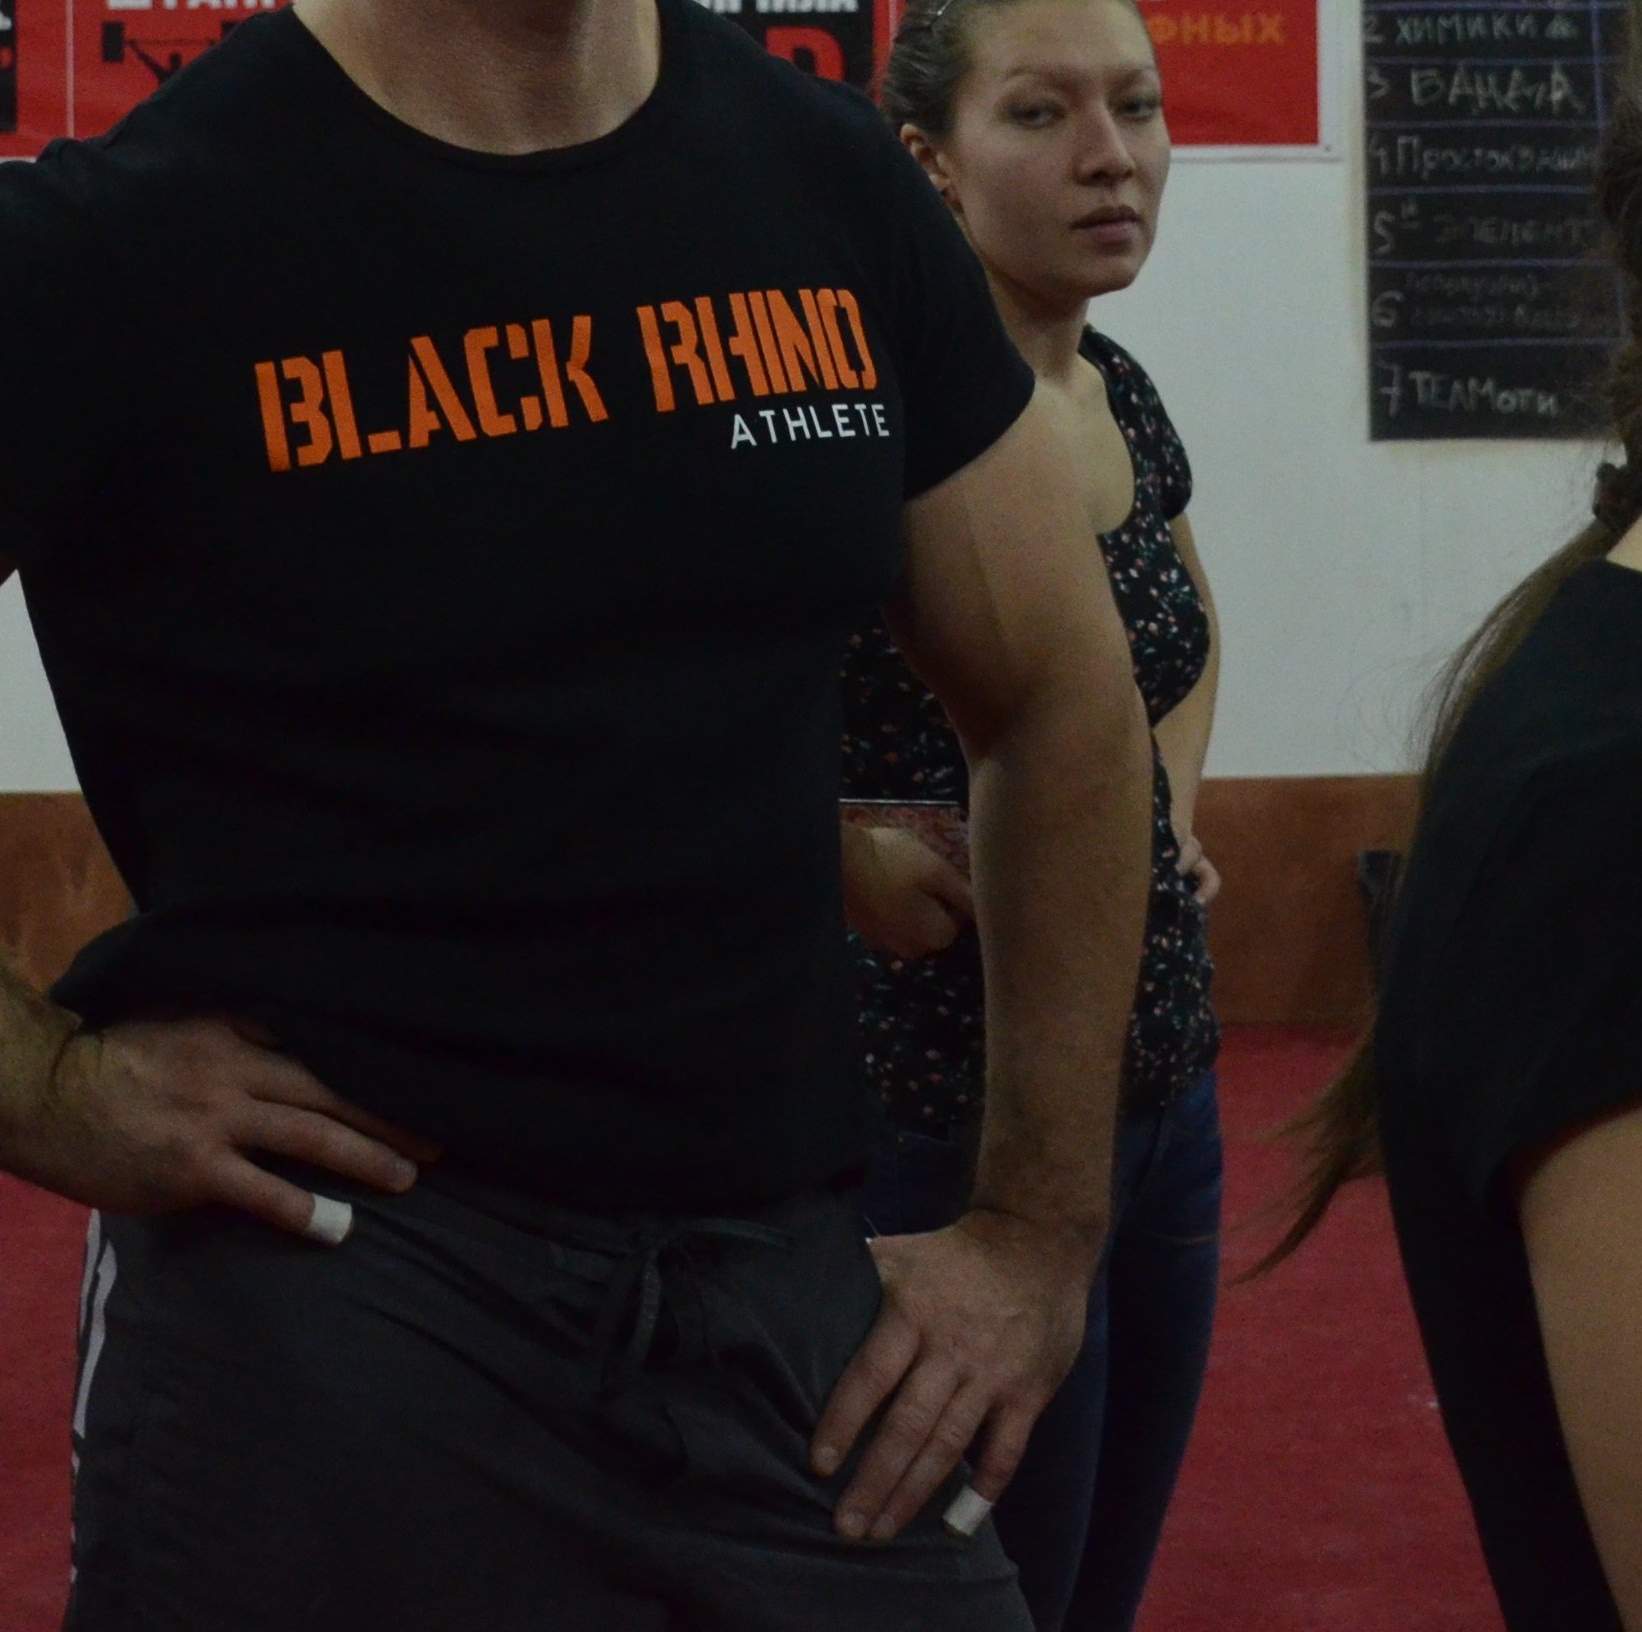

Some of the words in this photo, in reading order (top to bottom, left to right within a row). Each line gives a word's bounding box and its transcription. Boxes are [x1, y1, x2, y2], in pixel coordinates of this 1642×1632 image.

[254, 314, 608, 473] BLACK
[636, 288, 878, 412] RHINO
[730, 403, 891, 450] ATHLETE
